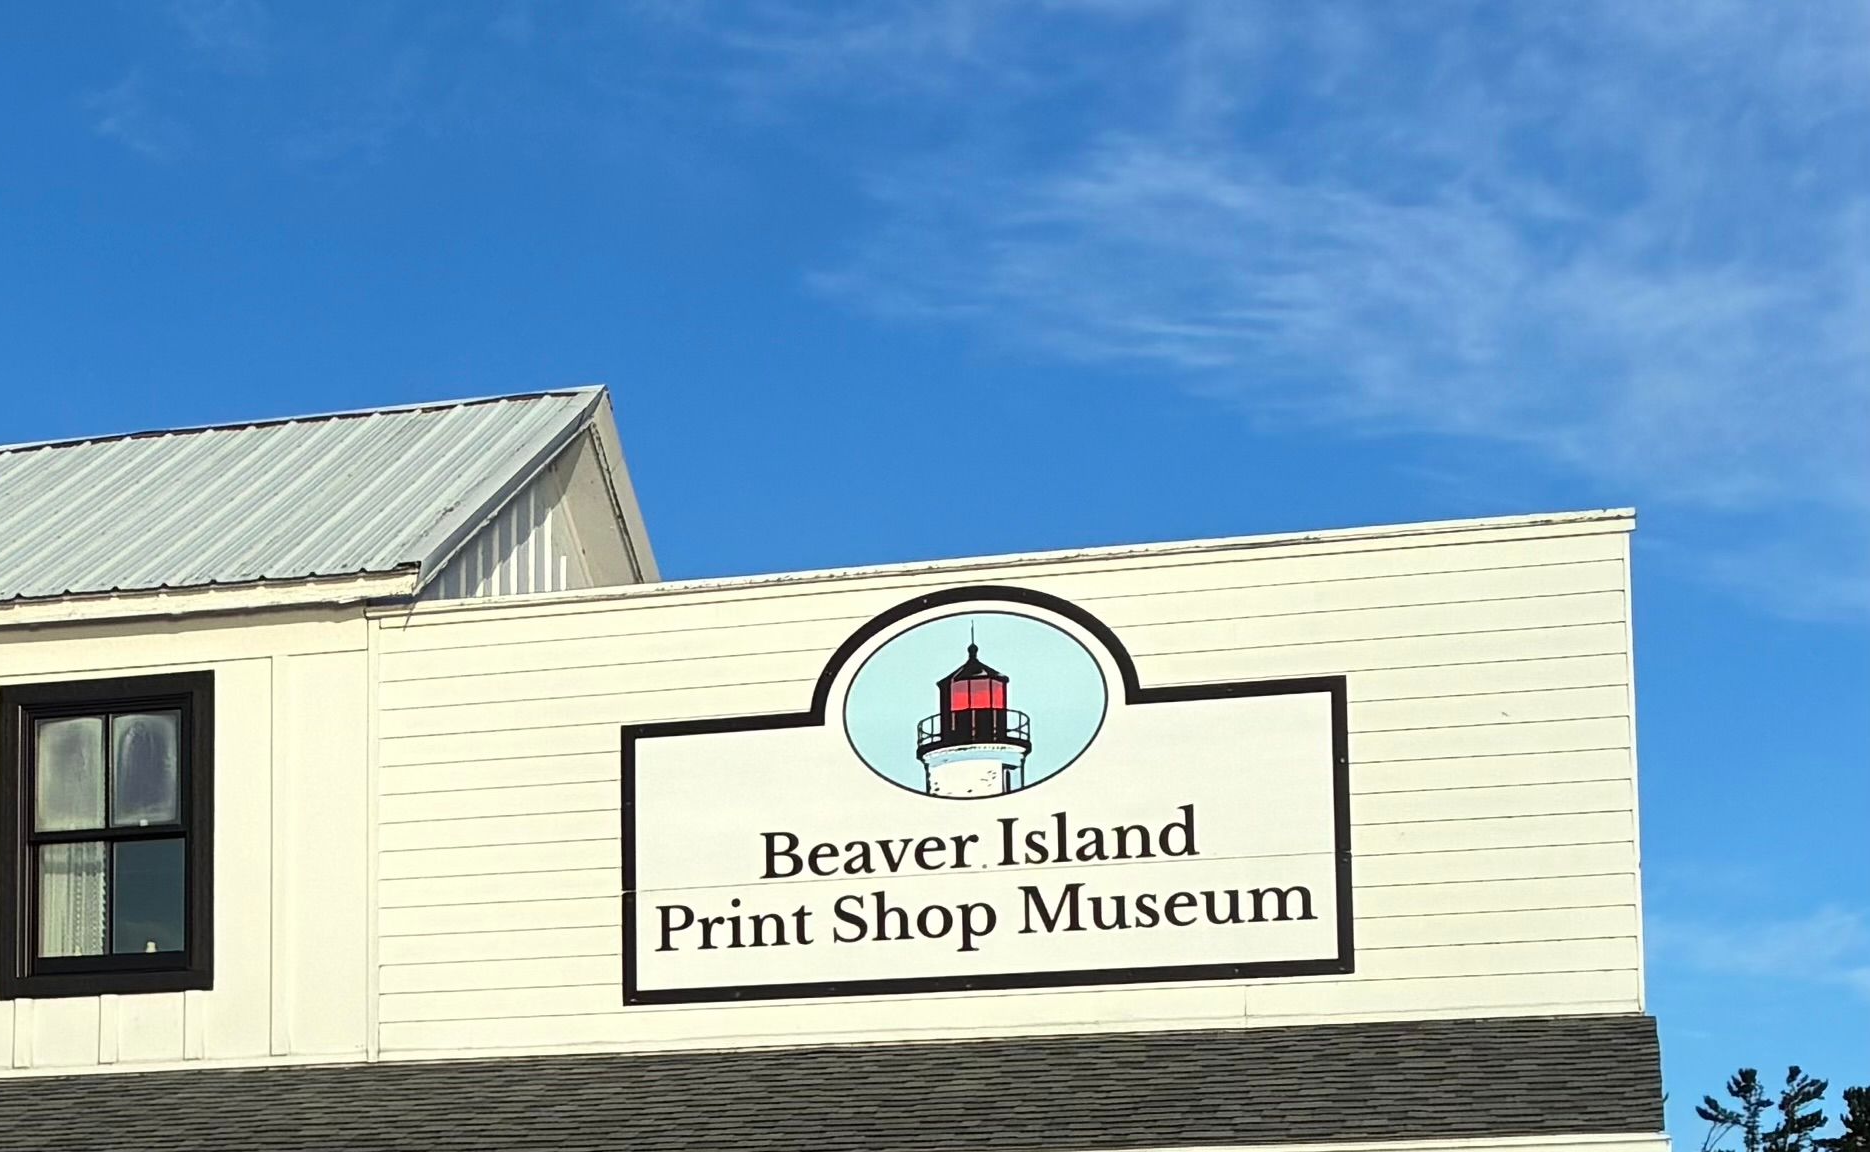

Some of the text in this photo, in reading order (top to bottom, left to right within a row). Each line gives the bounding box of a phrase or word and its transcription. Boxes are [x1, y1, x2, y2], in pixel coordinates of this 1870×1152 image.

[759, 803, 1201, 880] Beaver Island
[654, 882, 1319, 953] Print Shop Museum
